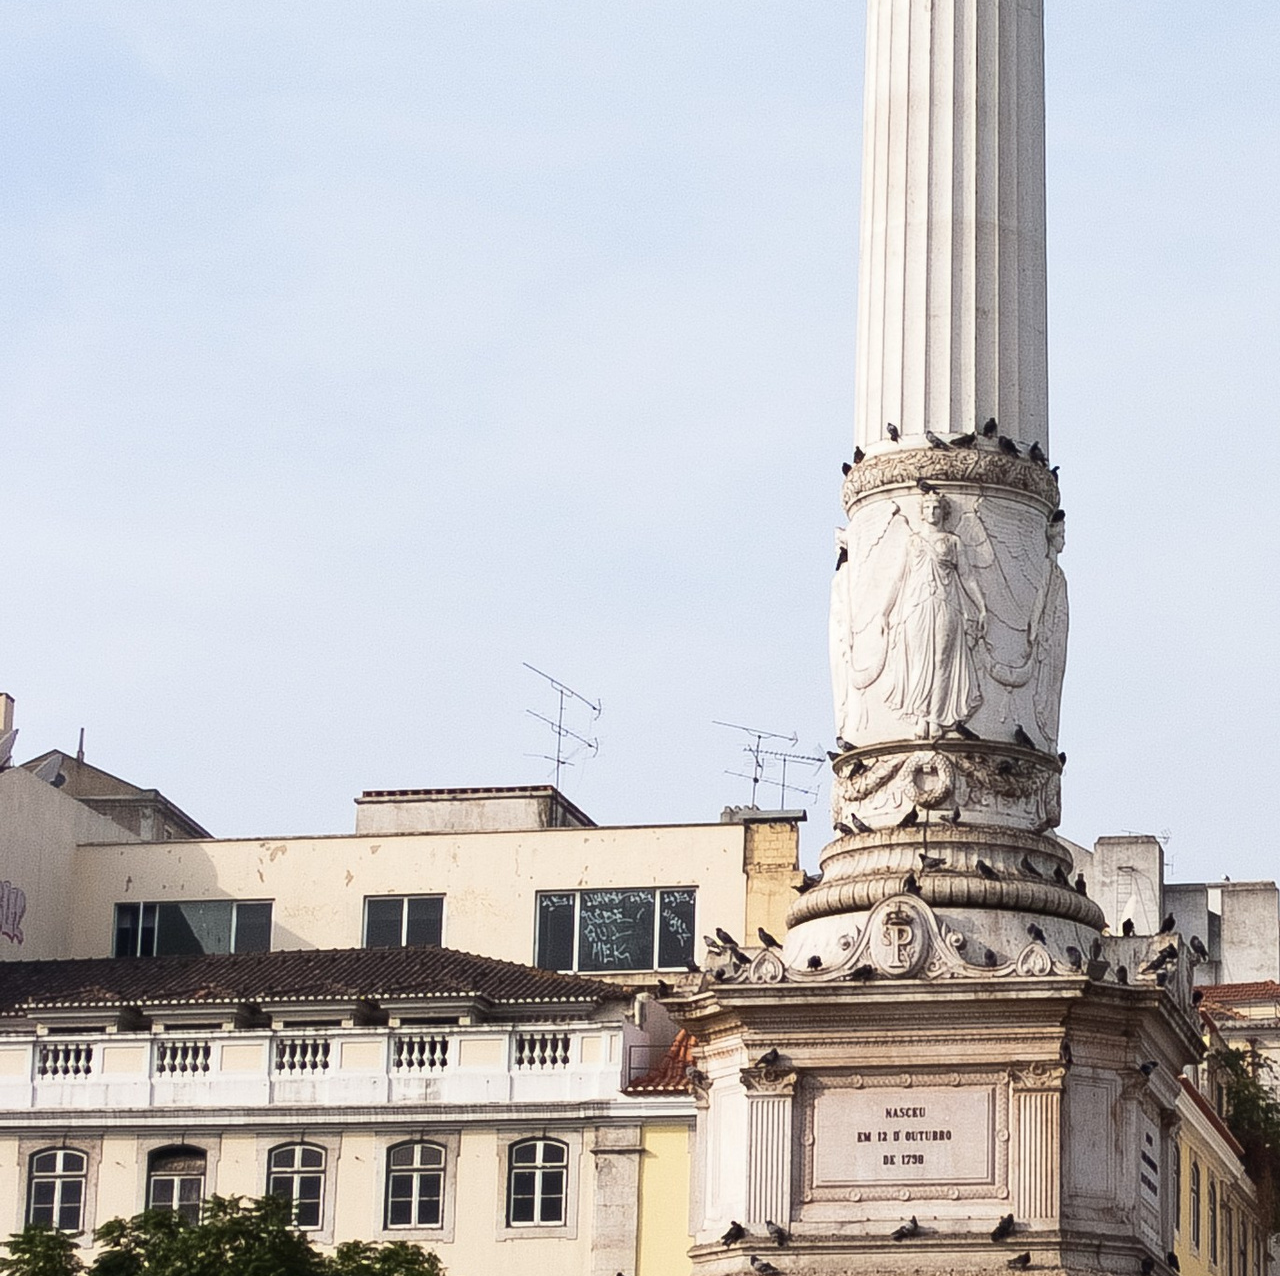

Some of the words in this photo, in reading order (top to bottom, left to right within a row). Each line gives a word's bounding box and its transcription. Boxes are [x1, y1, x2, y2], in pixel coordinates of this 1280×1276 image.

[885, 1107, 926, 1119] NASCEU
[857, 1131, 872, 1143] EM
[877, 1131, 888, 1142] 12
[905, 1130, 952, 1142] OUTUBRO
[883, 1154, 896, 1165] DE
[901, 1154, 924, 1165] 1798
